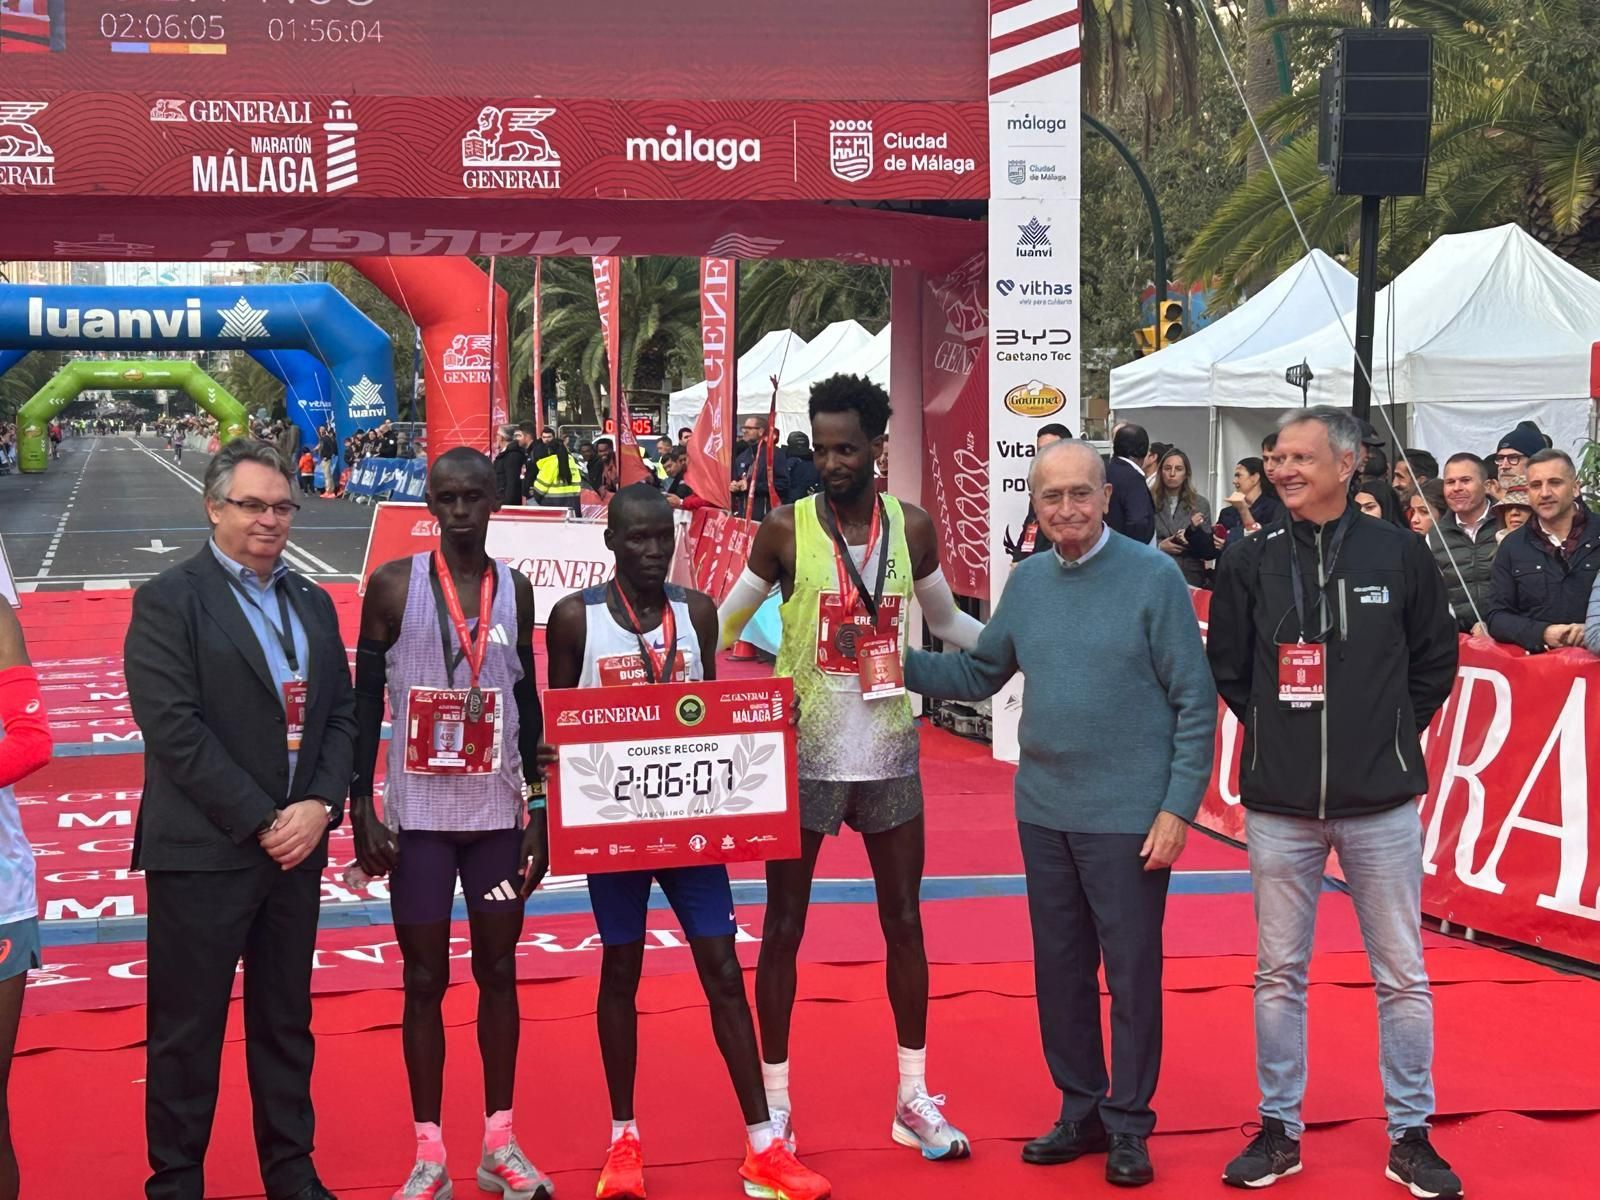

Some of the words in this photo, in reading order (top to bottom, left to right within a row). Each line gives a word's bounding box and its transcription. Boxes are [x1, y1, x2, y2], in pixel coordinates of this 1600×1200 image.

[101, 13, 226, 40] 02:06:05
[269, 18, 384, 43] 01:56:04
[189, 100, 312, 124] GENERALI
[251, 134, 312, 154] MARATÓN
[883, 131, 948, 150] Ciudad
[192, 148, 318, 193] MÁLAGA
[884, 154, 908, 172] de
[911, 154, 976, 175] Málaga
[1029, 164, 1056, 172] Ciudad
[463, 170, 561, 190] GENERALI
[1016, 246, 1053, 258] luanvi
[1019, 280, 1072, 296] vithas
[28, 297, 201, 339] luanvi
[996, 329, 1072, 345] BYD
[996, 351, 1048, 361] Caetano
[443, 371, 491, 384] GENERA
[1011, 394, 1059, 405] Gourmet
[348, 405, 387, 418] luanvi
[996, 440, 1036, 458] Vita
[1002, 478, 1029, 492] PO
[581, 705, 661, 725] GENERALI
[732, 709, 771, 724] MÁLAGA
[627, 745, 672, 757] COURSE
[674, 742, 719, 754] RECORD
[614, 759, 734, 801] 2:06:07
